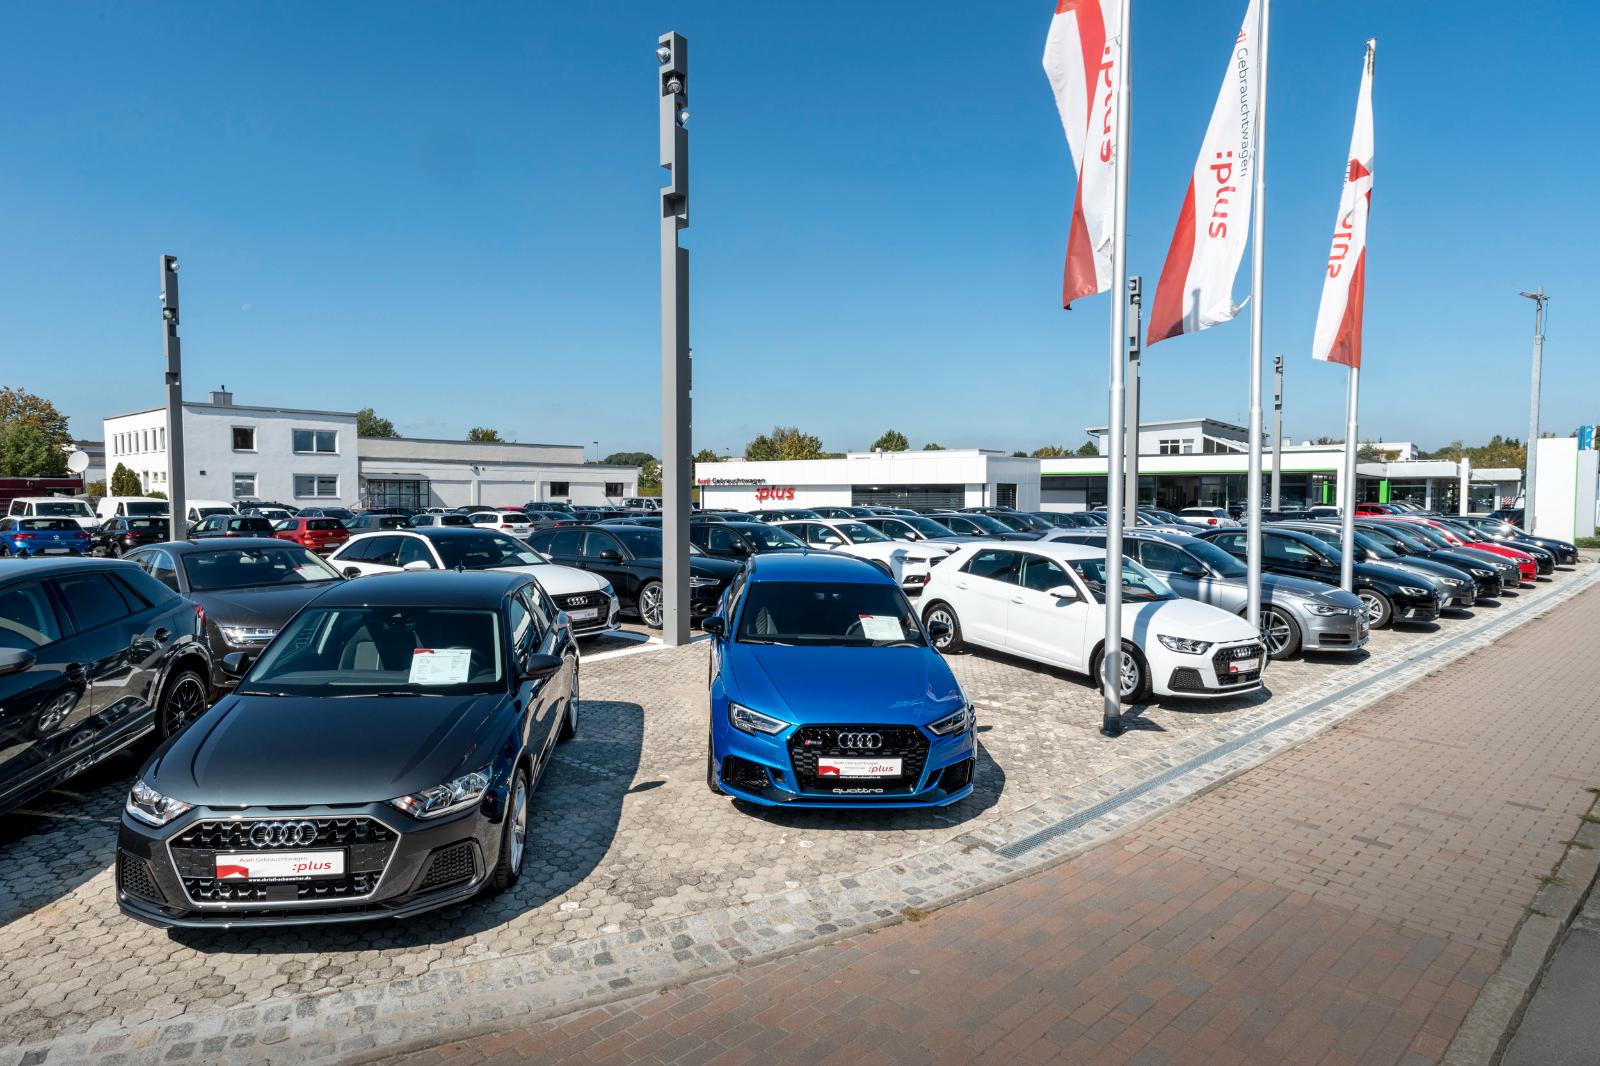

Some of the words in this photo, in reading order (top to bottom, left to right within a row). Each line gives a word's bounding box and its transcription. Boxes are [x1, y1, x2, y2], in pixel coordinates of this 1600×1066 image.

[1236, 47, 1251, 177] Gebrauchtwagen
[1208, 151, 1236, 239] :plus
[712, 477, 766, 485] Gebrauchtwagen
[869, 765, 894, 773] :plus
[292, 860, 332, 873] :plus
